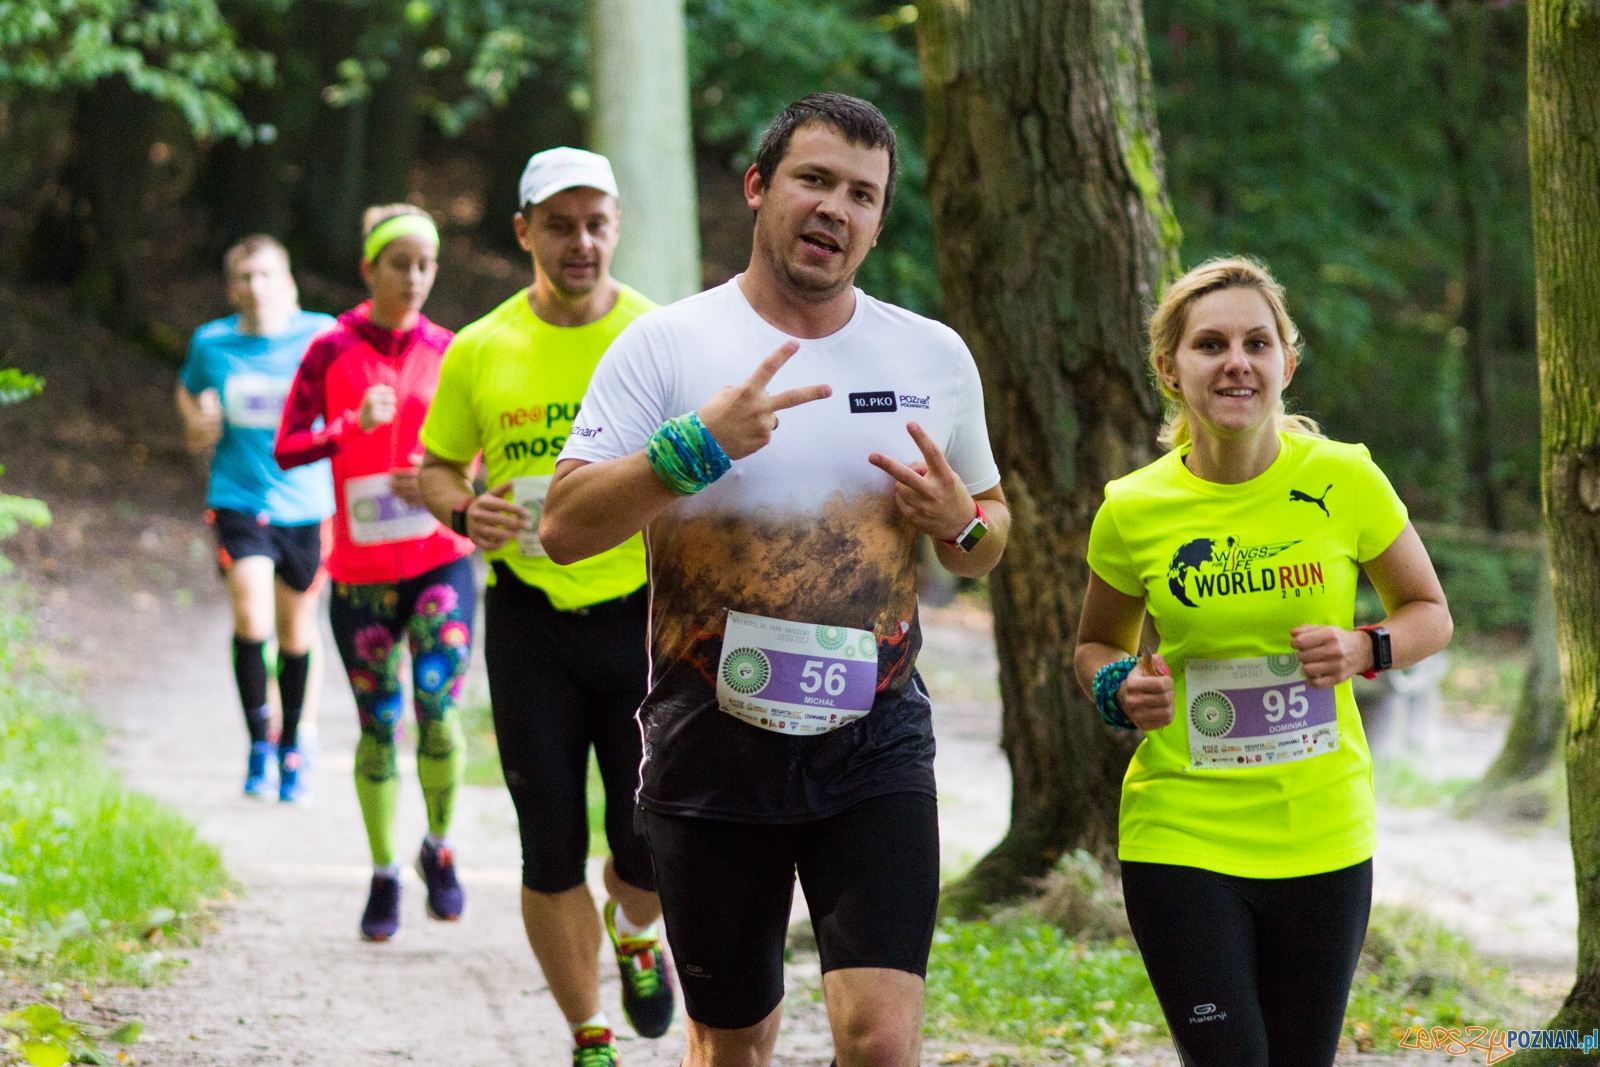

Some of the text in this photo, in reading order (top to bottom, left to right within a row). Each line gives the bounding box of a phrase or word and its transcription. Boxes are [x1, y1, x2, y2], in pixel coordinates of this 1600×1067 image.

[854, 396, 893, 407] 10. PKO
[1214, 546, 1268, 562] WINGS
[1222, 559, 1253, 573] LIFE
[1194, 561, 1324, 598] WORLD RUN
[1281, 589, 1325, 599] 2017
[800, 660, 847, 696] 56
[804, 696, 835, 706] MICHAŁ
[1262, 685, 1309, 723] 95
[1269, 720, 1308, 733] DOMINIKA
[1189, 1010, 1227, 1024] Kalenji
